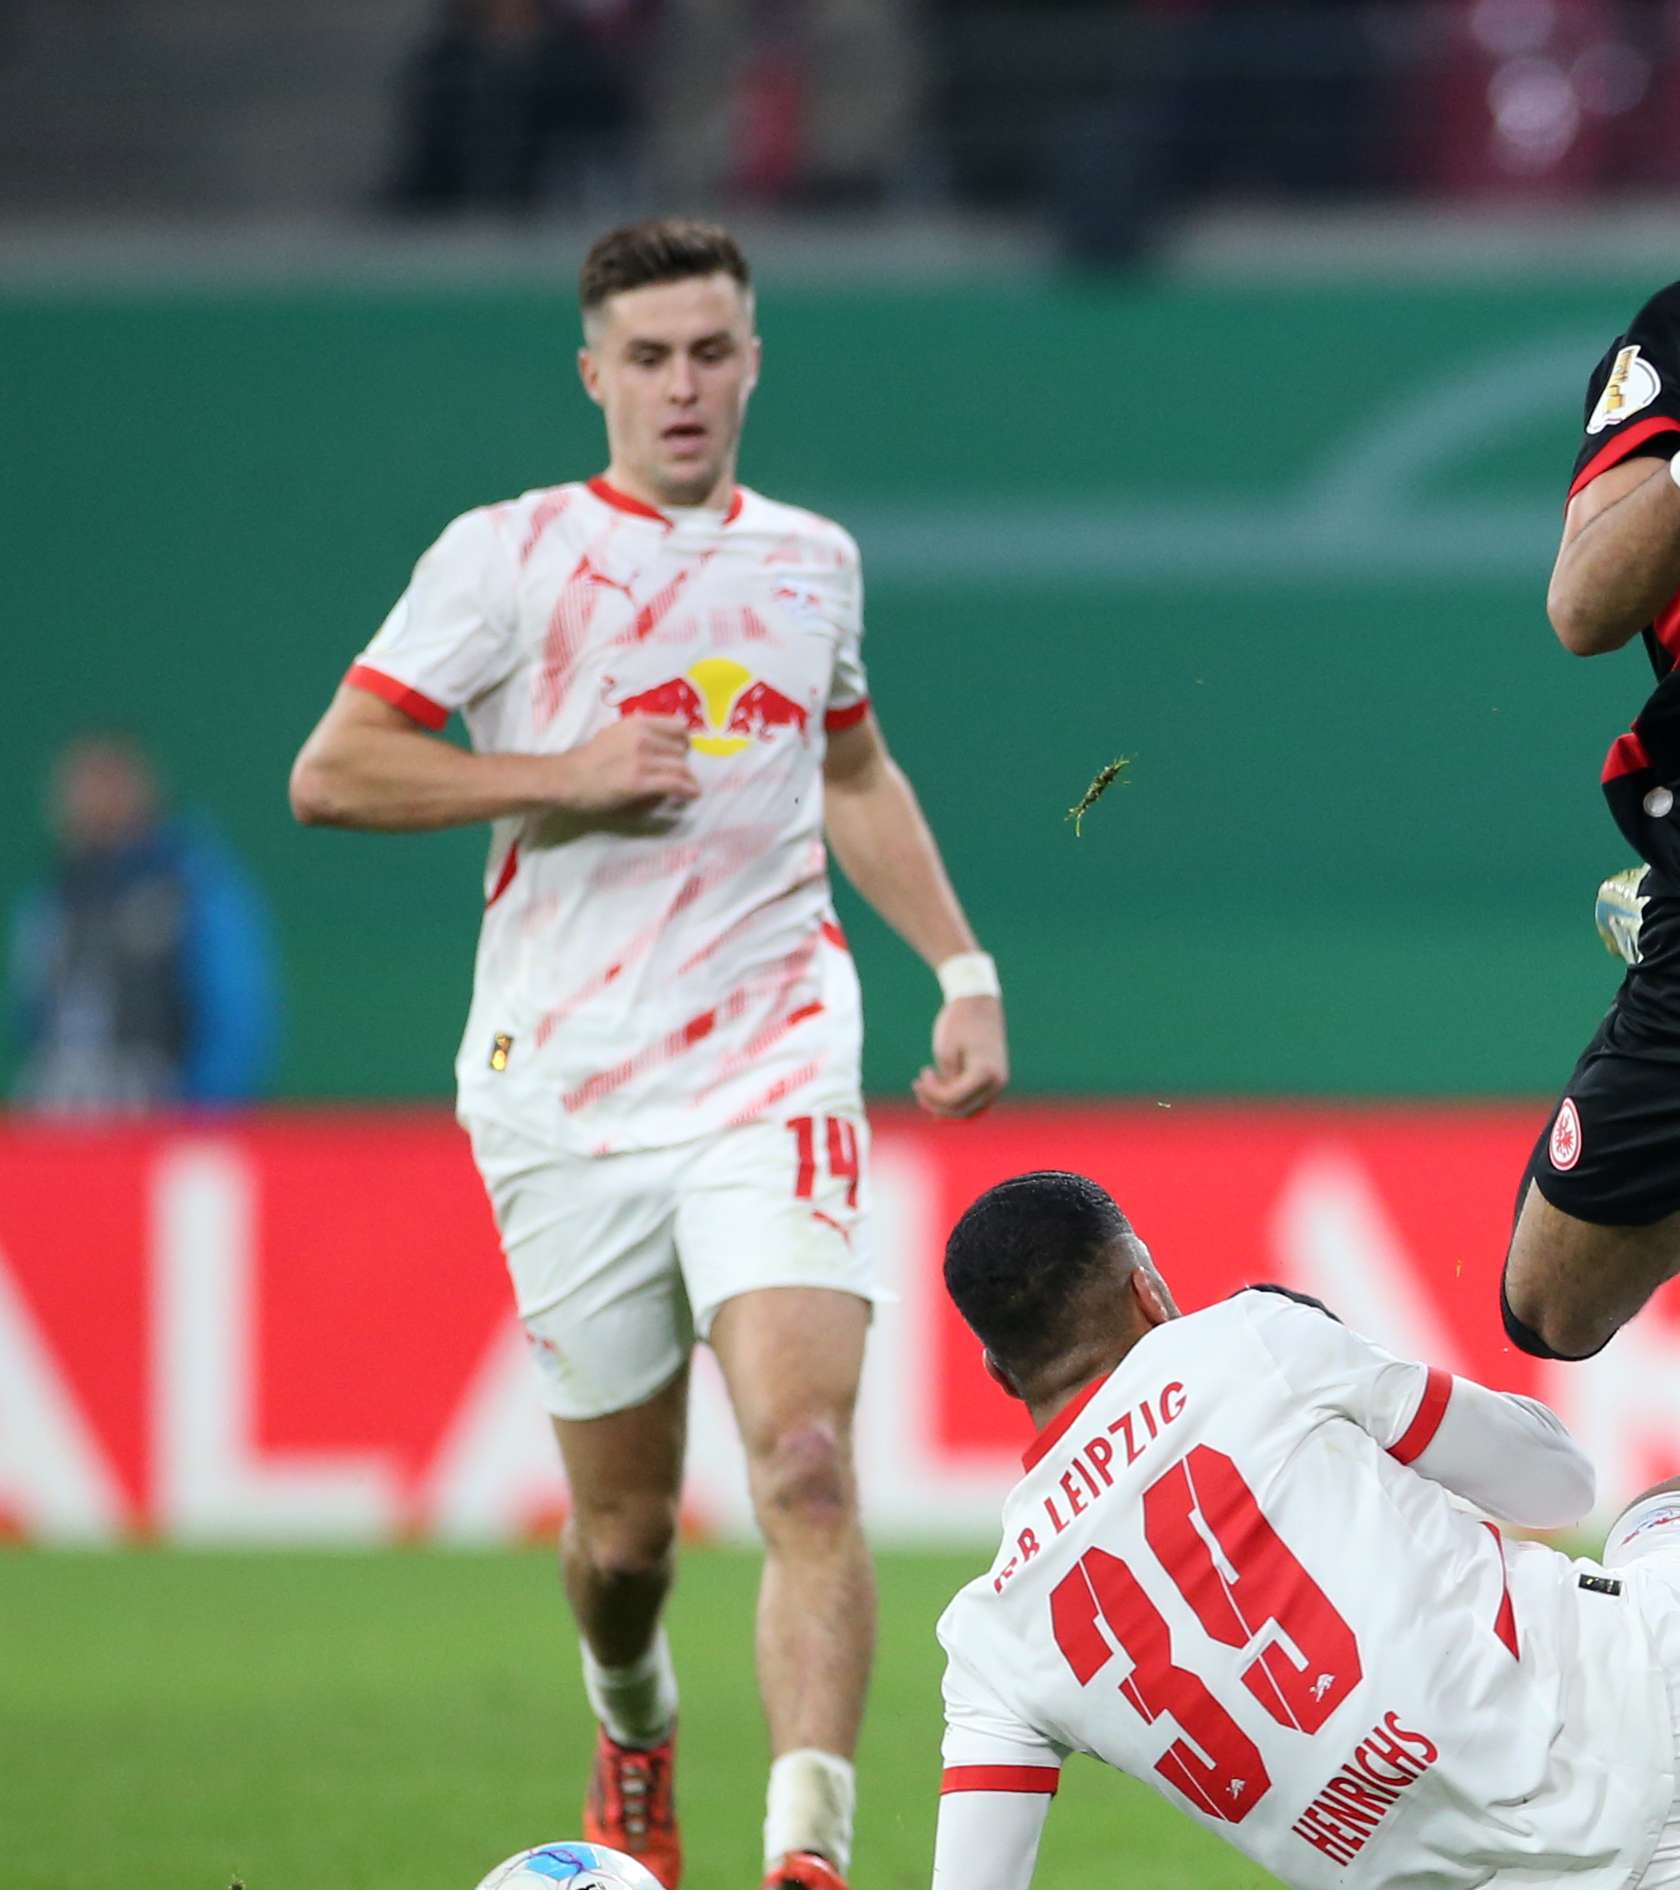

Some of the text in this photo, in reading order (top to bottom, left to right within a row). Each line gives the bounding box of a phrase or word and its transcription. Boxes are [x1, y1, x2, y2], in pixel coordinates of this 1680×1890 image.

[785, 1114, 860, 1210] 14
[1044, 1381, 1187, 1534] LEIPZIG
[1050, 1443, 1363, 1824] 39
[1291, 1711, 1438, 1867] HENRICHS
